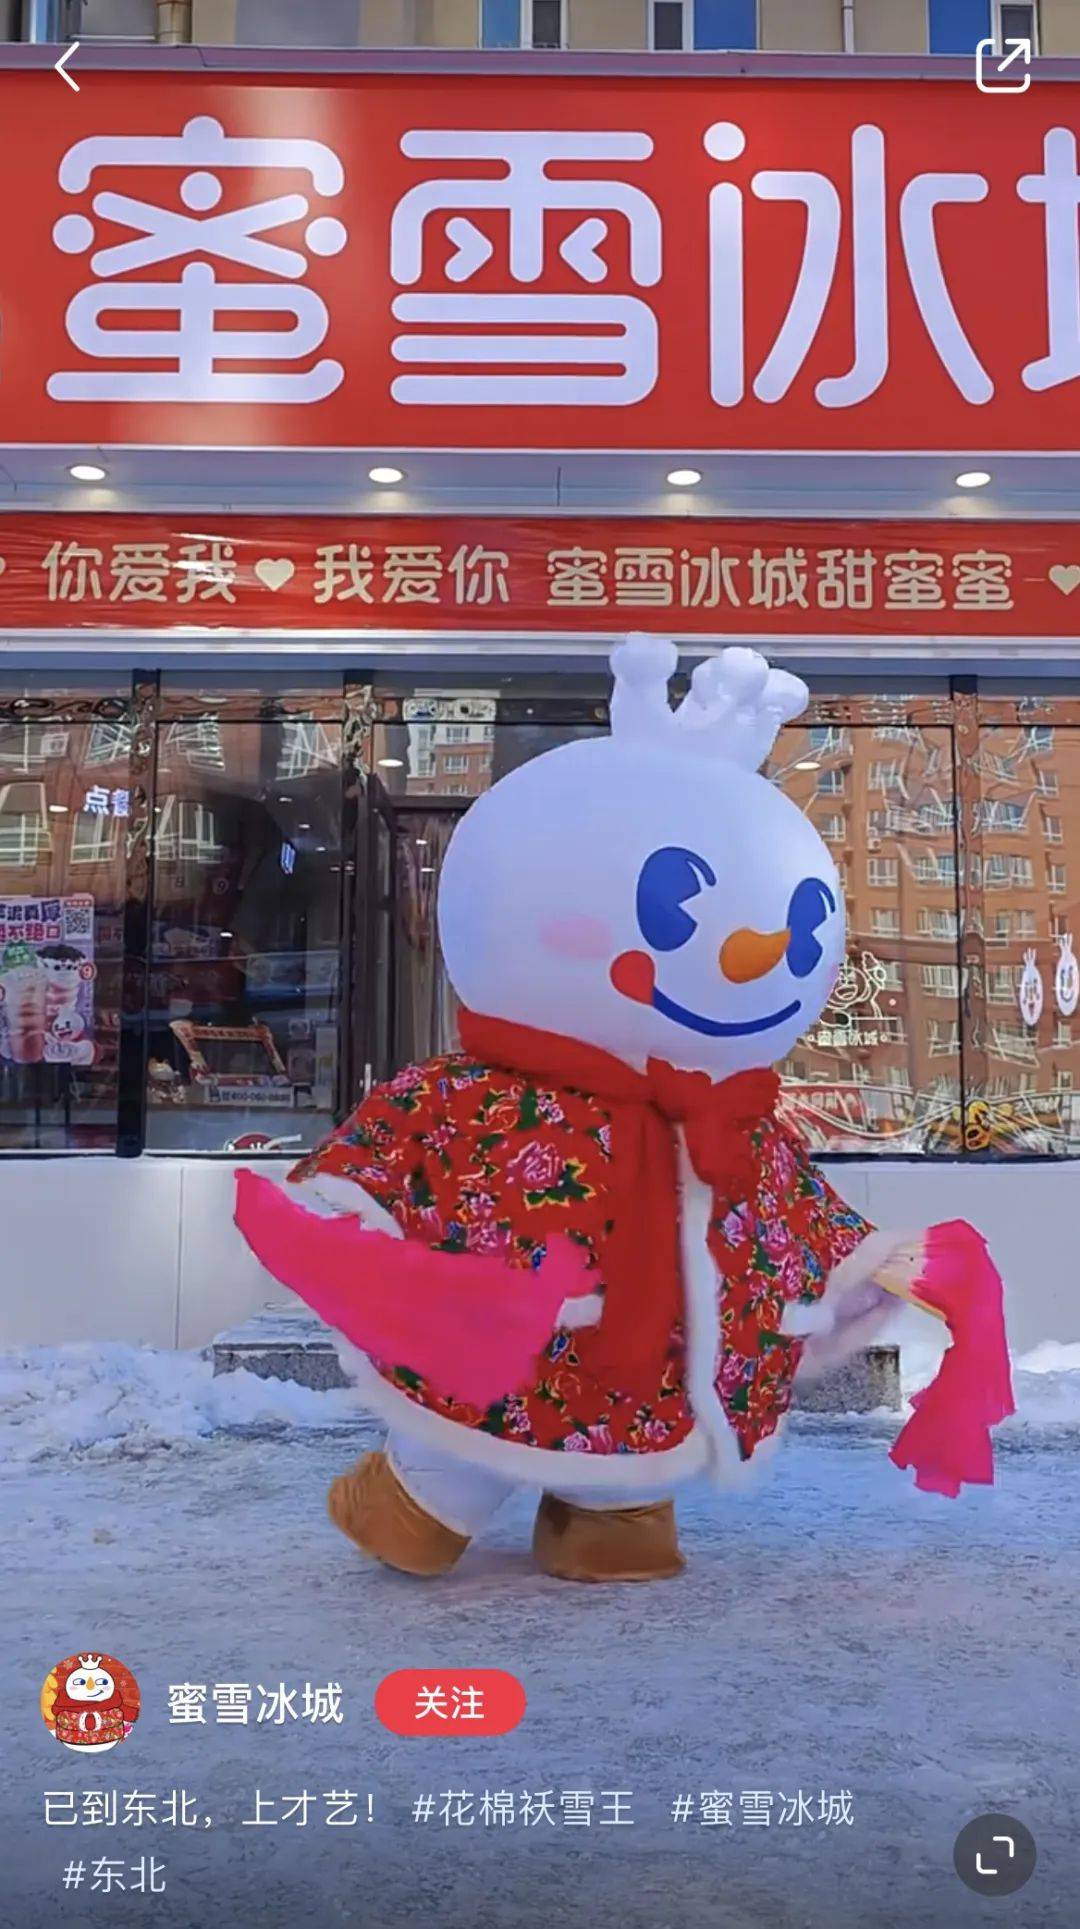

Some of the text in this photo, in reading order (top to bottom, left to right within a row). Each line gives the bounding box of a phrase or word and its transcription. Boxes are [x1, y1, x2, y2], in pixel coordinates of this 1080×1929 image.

[41, 540, 1014, 610] 你爱我 我爱你 蜜雪冰城甜蜜蜜
